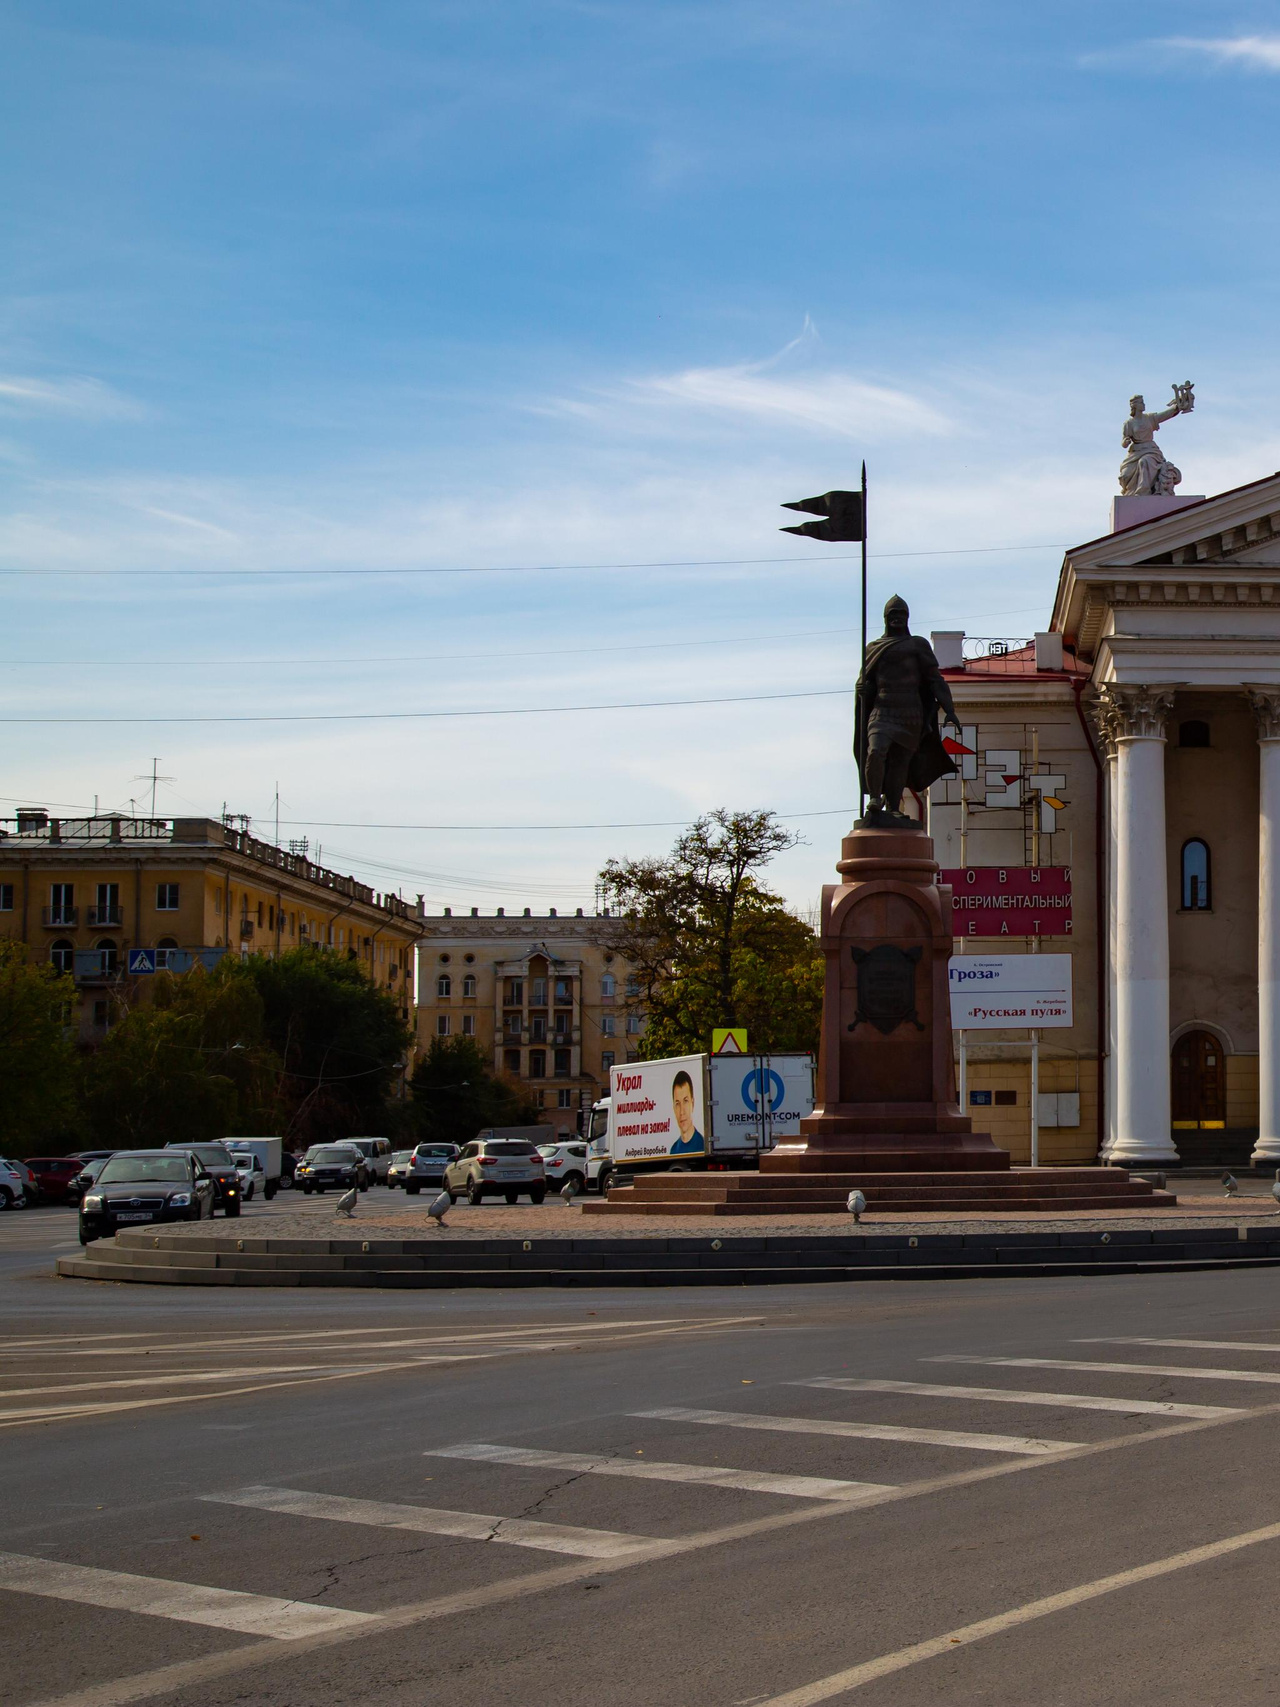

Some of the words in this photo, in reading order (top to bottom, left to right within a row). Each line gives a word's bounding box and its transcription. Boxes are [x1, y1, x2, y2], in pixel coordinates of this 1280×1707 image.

[990, 644, 1007, 655] НЭТ
[940, 725, 1066, 834] НЭТ
[933, 868, 1072, 884] НОВЫЙ
[951, 893, 1073, 910] СПЕРИМЕНТАЛЬНЫЙ
[968, 920, 1073, 934] ЕАТР
[968, 1007, 1026, 1019] «Русская
[1030, 1008, 1067, 1019] пуля»
[616, 1073, 642, 1095] Украл
[616, 1097, 656, 1115] миллиарды-
[617, 1123, 640, 1137] плевал
[641, 1123, 648, 1134] на
[649, 1118, 670, 1134] закон!
[624, 1147, 643, 1158] Андрей
[643, 1145, 667, 1157] Воробьёв
